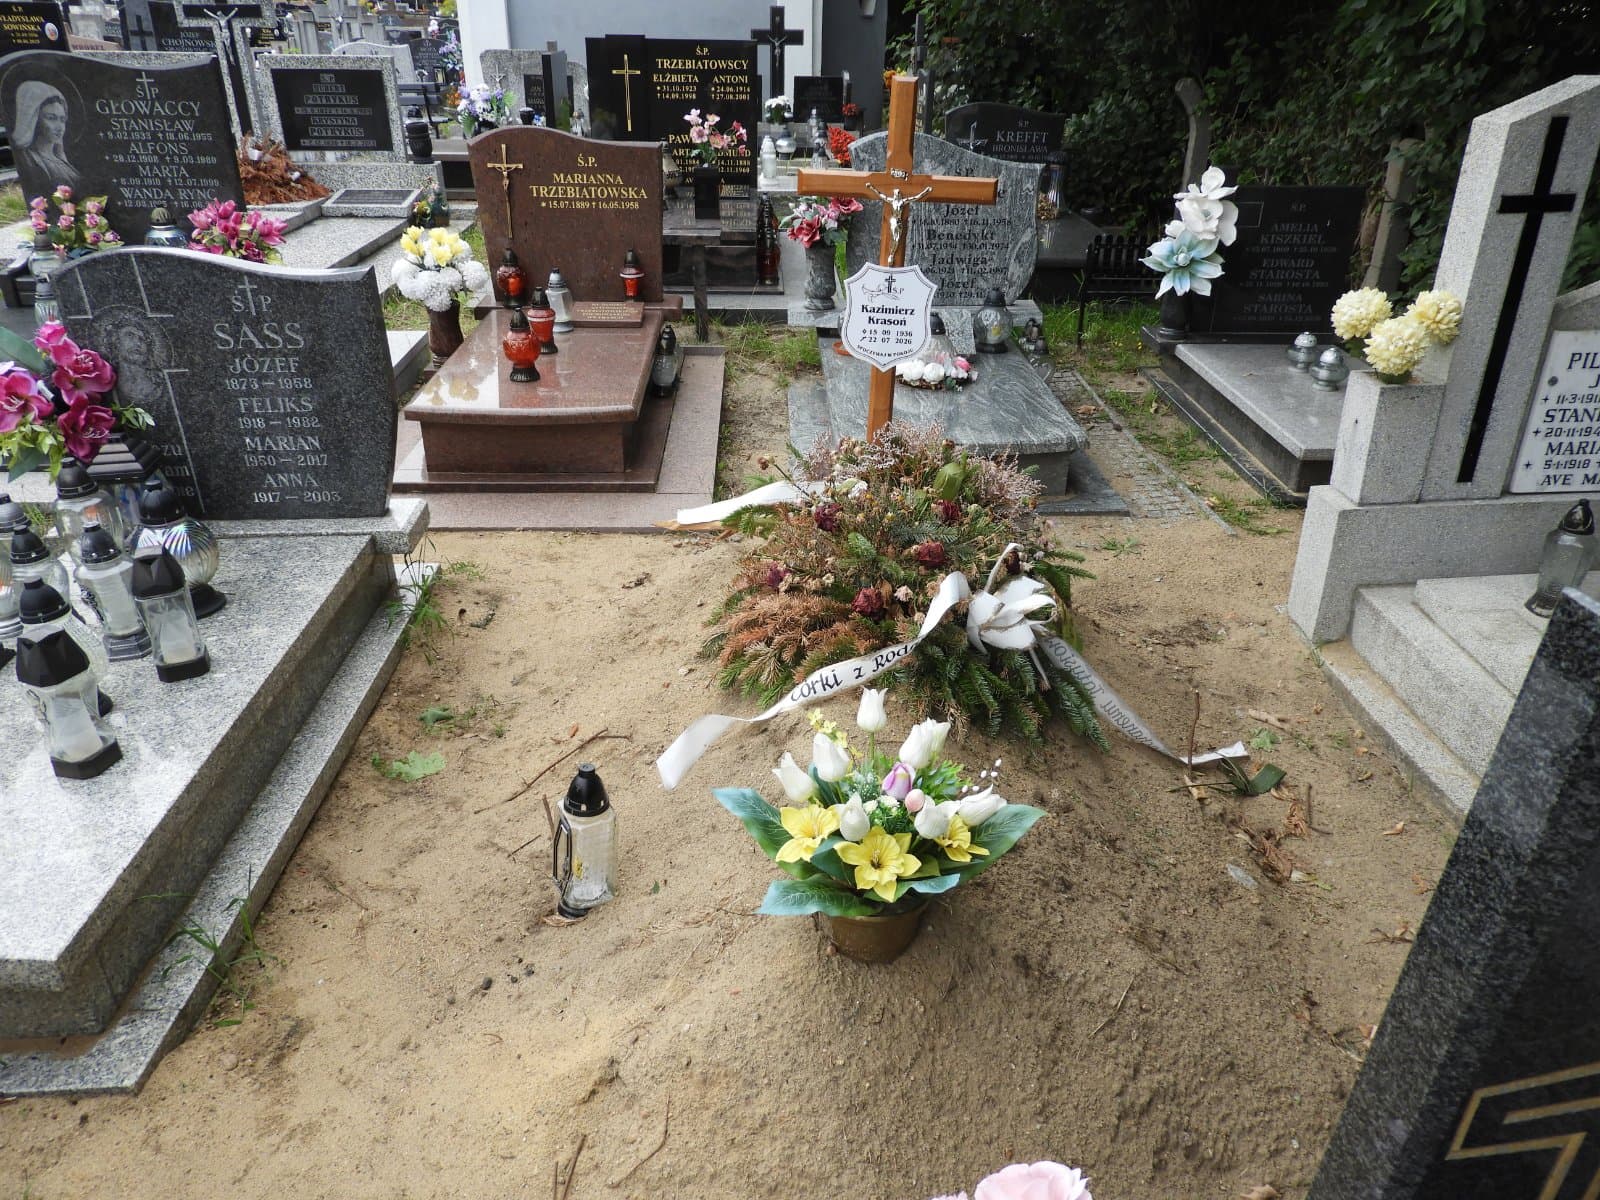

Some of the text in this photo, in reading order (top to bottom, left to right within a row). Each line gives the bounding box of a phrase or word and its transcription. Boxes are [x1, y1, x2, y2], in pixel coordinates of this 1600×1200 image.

[655, 58, 749, 70] TRZEBIATOWSCY
[653, 72, 699, 83] ELŻBIETA
[712, 75, 749, 84] ANTONI
[151, 87, 159, 98] P
[95, 99, 201, 117] GŁOWACCY
[110, 117, 195, 132] STANISŁAW
[995, 129, 1049, 143] KREFFT
[129, 141, 189, 155] ALFONS
[138, 164, 190, 178] MARTA
[552, 172, 624, 185] MARIANNA
[120, 187, 216, 200] WANDA RYNC
[529, 185, 648, 199] TRZEBIATOWSKA
[549, 200, 590, 209] 15.07.1889
[931, 253, 988, 267] Jadwiga
[1249, 269, 1321, 280] STAROSTA
[861, 304, 915, 315] Kazimierz
[868, 316, 907, 326] Krasoń
[213, 322, 305, 350] SASS
[229, 354, 300, 374] JÓZEF
[238, 396, 313, 413] FELIKS
[238, 416, 266, 429] 1918
[286, 416, 321, 428] 1982
[243, 435, 322, 451] MARIAN
[297, 454, 328, 466] 2017
[263, 473, 320, 488] ANNA
[1540, 473, 1574, 486] AVE
[253, 491, 281, 503] 1917
[853, 666, 866, 680] z
